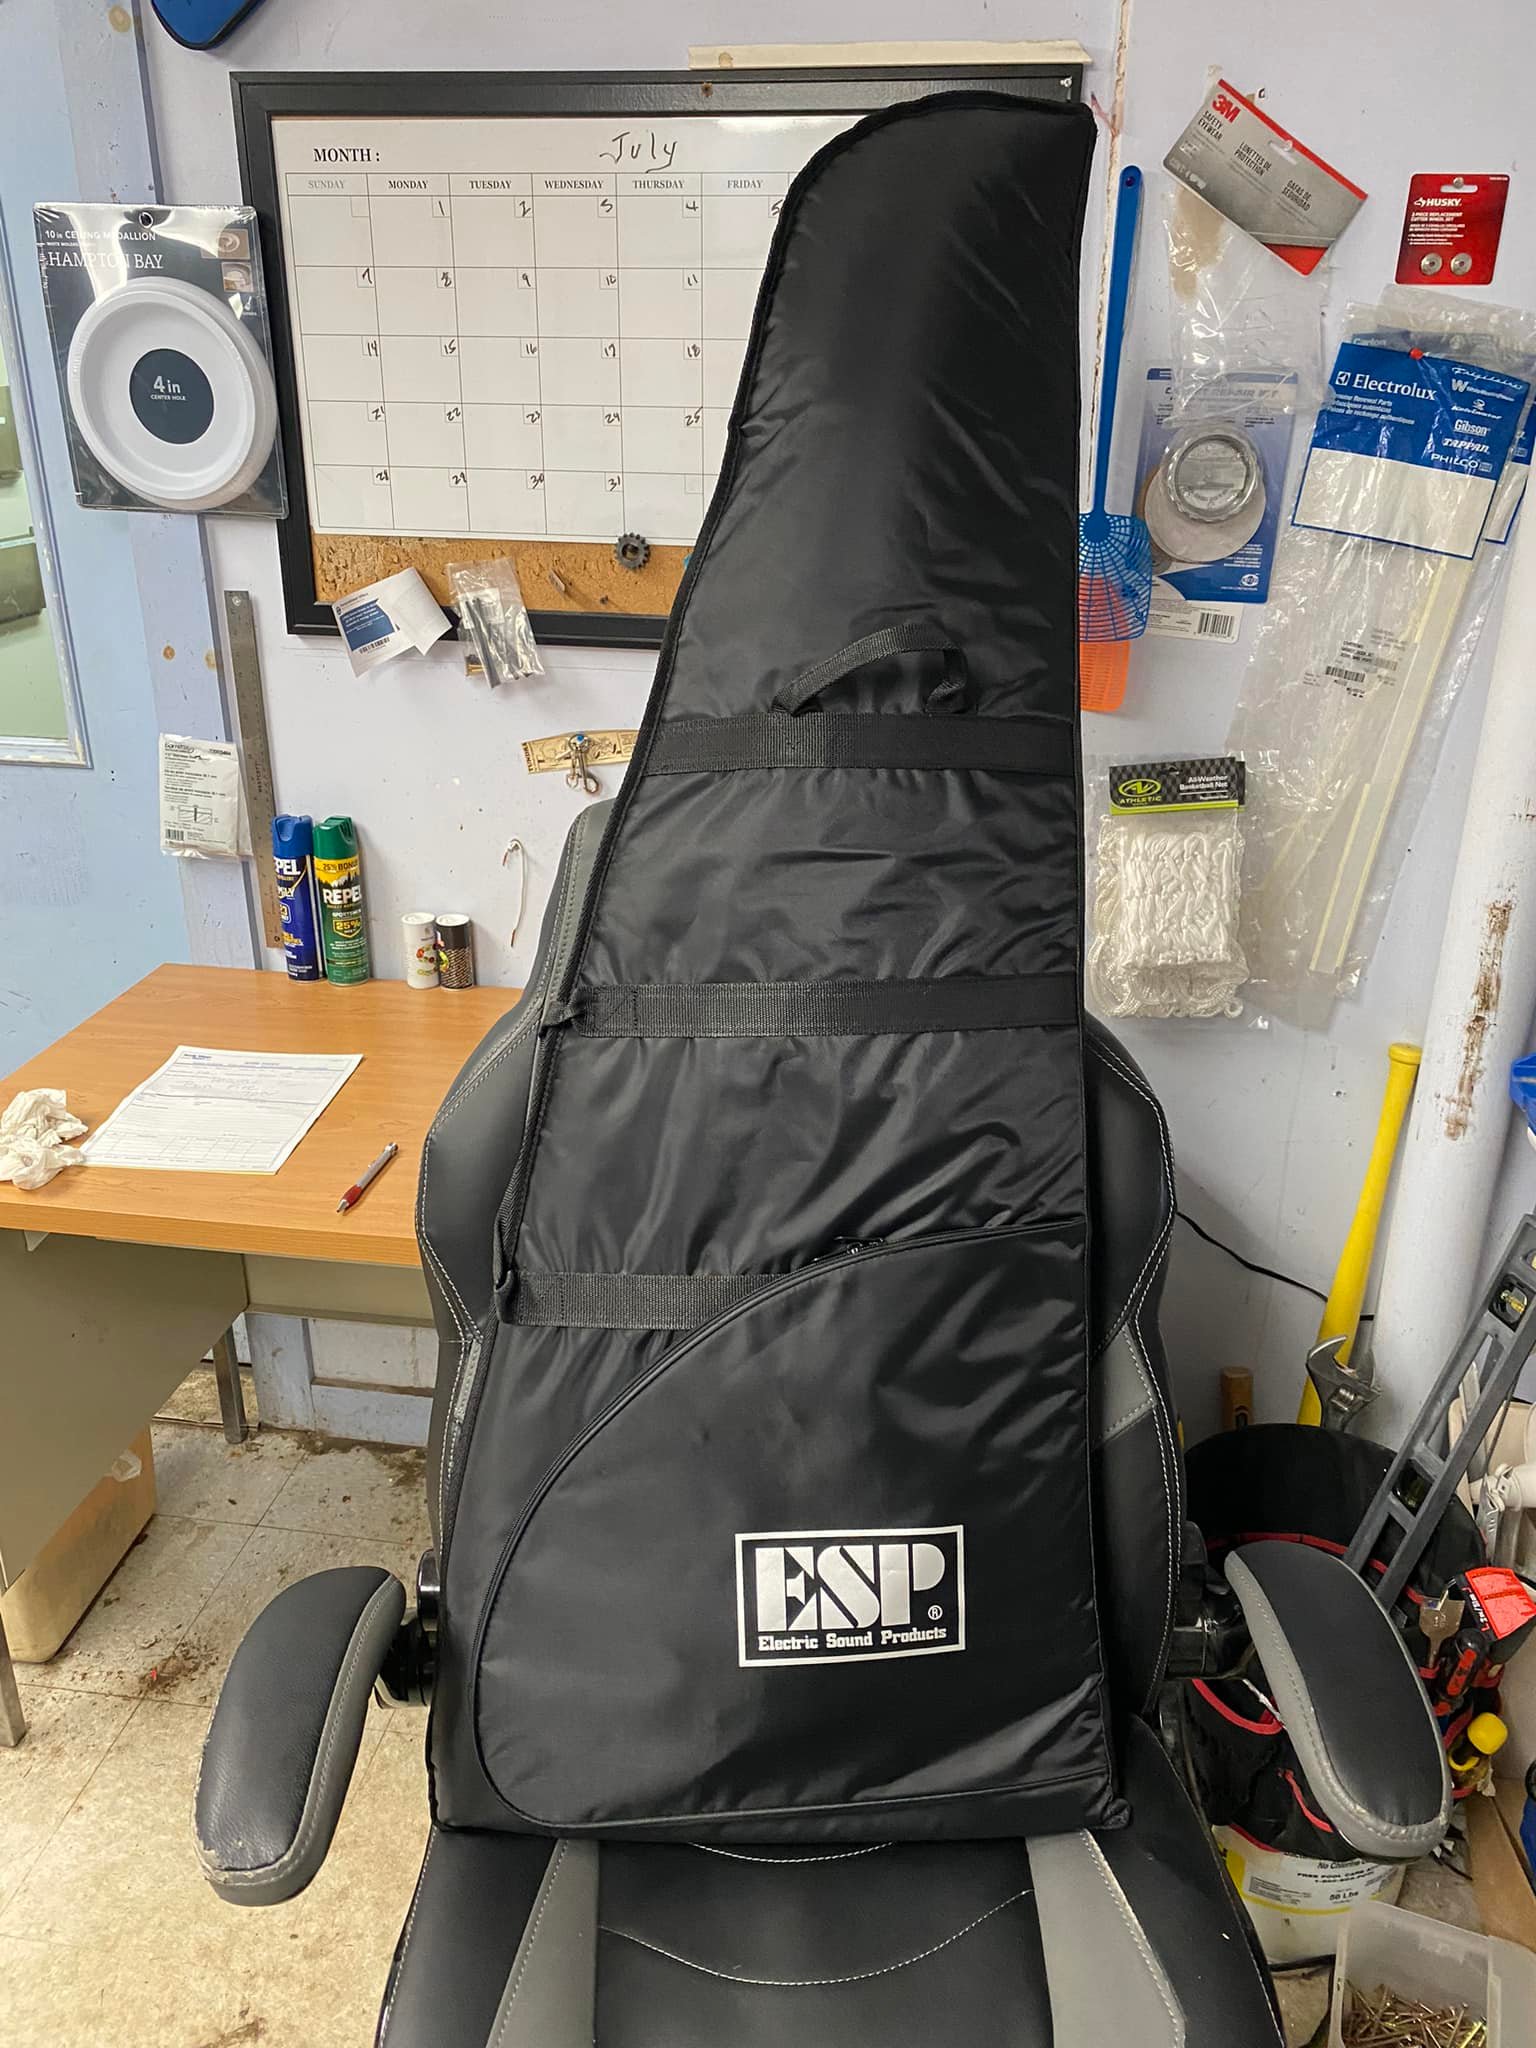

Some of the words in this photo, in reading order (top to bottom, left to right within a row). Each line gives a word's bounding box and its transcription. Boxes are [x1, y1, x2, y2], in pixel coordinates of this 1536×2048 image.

[1212, 94, 1241, 123] 3M
[1203, 110, 1223, 130] SAFETY
[1198, 118, 1223, 141] EYEWEAR
[599, 132, 677, 173] July
[1240, 142, 1265, 165] LUNETTES
[1263, 160, 1272, 171] DE
[1234, 149, 1264, 176] PROTECTION
[308, 180, 345, 190] SUNDAY
[388, 180, 428, 190] MONDAY
[469, 180, 512, 190] TUESDAY
[545, 180, 604, 190] WEDNESDAY
[632, 180, 685, 190] THURSDAY
[727, 180, 763, 190] FRIDAY
[1287, 180, 1304, 195] GAFAS
[686, 201, 699, 212] 4
[1281, 187, 1311, 211] SEGURIDAD
[1426, 198, 1461, 207] HUSKY
[519, 201, 531, 217] 2
[45, 230, 56, 239] 10
[47, 251, 130, 269] HAMPTON
[134, 254, 164, 269] BAY
[522, 273, 532, 287] 9
[606, 274, 617, 286] 10
[687, 274, 698, 286] 11
[367, 340, 379, 357] 14
[444, 339, 457, 355] 15
[526, 343, 538, 355] 16
[604, 343, 617, 357] 17
[687, 344, 701, 358] 18
[153, 375, 166, 394] 4
[167, 379, 181, 394] in
[1352, 373, 1437, 401] Electrolux
[446, 407, 461, 422] 22
[604, 412, 620, 424] 24
[684, 406, 703, 426] 25
[1454, 419, 1489, 436] Gibson
[1442, 438, 1490, 454] TAPPAN
[1431, 453, 1479, 468] PHILCO
[452, 471, 467, 485] 29
[530, 473, 545, 489] 30
[608, 476, 621, 491] 31
[1120, 796, 1162, 804] ATHLETIC
[273, 857, 301, 876] PEL
[336, 920, 361, 930] 25%
[755, 1543, 946, 1632] ESP
[758, 1633, 819, 1651] Electric
[826, 1631, 873, 1649] Sound
[881, 1627, 947, 1645] Products
